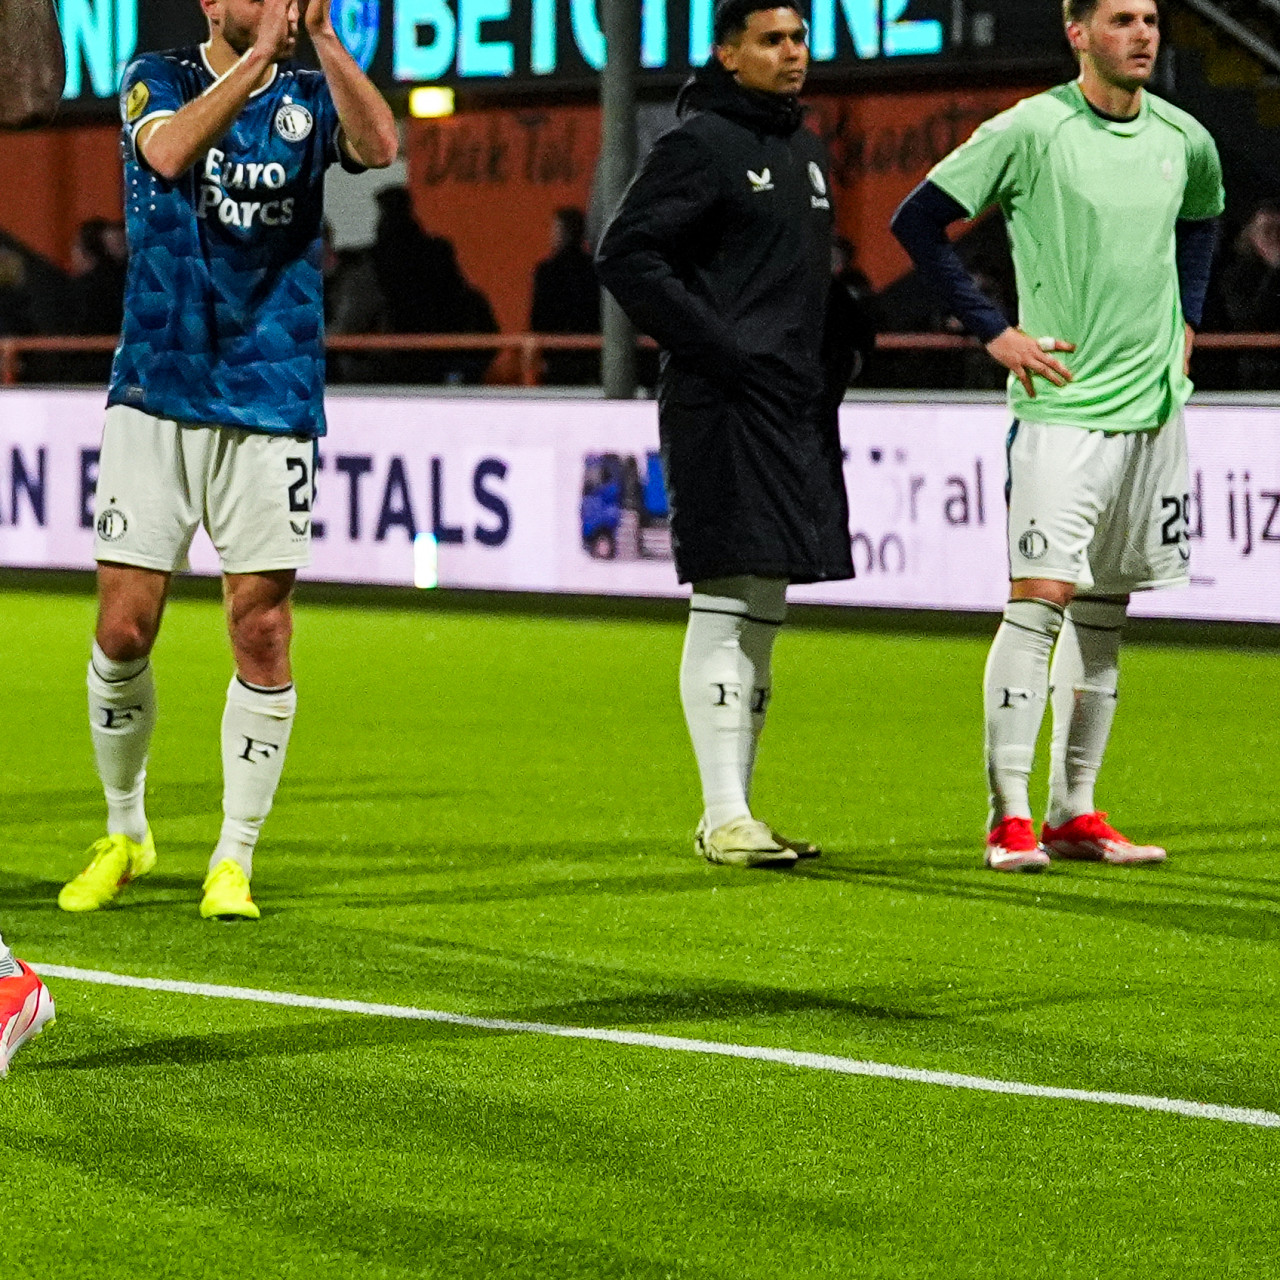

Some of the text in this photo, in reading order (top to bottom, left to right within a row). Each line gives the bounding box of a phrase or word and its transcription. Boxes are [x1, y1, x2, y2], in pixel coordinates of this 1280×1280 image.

[204, 147, 286, 190] Euro
[197, 183, 295, 229] Parcs
[945, 457, 987, 527] al
[238, 735, 279, 765] F
